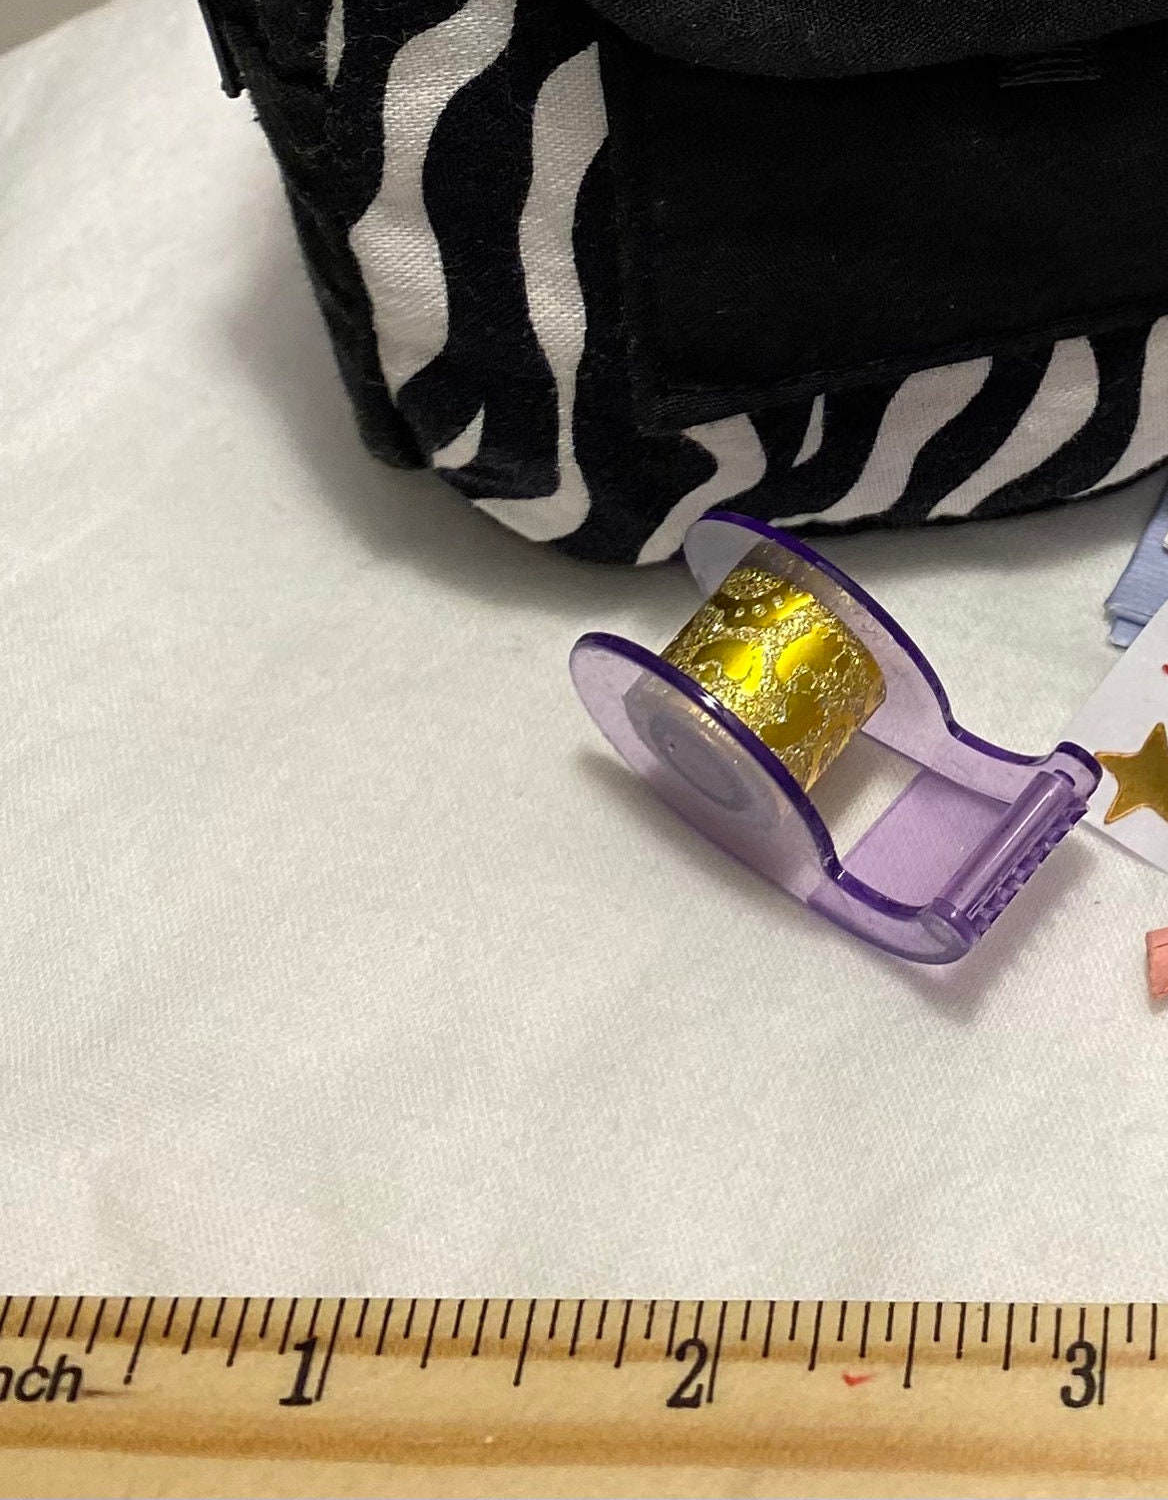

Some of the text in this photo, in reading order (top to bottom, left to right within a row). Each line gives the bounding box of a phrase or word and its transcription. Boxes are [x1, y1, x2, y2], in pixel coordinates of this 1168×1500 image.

[279, 1335, 318, 1406] 1
[666, 1338, 708, 1409] 2
[1060, 1340, 1097, 1408] 3
